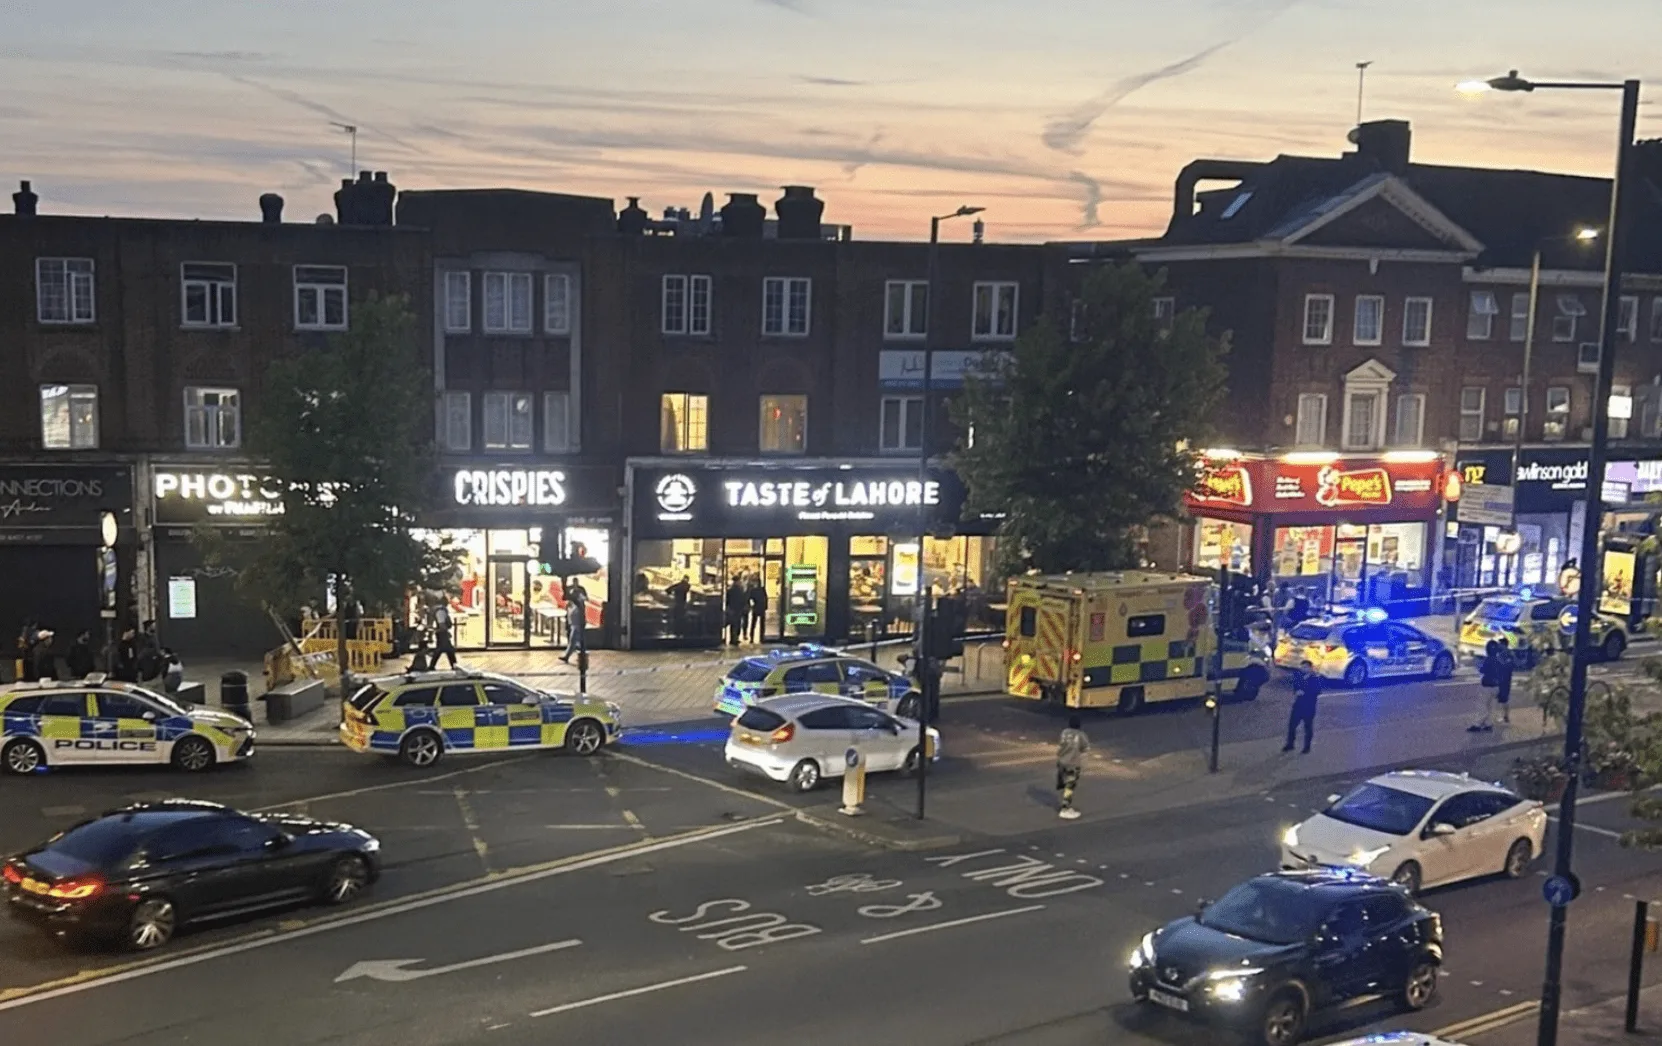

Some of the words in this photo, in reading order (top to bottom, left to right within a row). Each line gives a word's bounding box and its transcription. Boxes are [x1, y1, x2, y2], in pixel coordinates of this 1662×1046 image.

[1515, 461, 1562, 481] awlinson
[1562, 460, 1589, 485] gold
[454, 469, 566, 506] CRISPIES
[724, 481, 811, 506] TASTE
[811, 481, 833, 507] of
[834, 481, 939, 506] LAHORE
[54, 739, 158, 751] POLICE
[648, 898, 823, 951] BUS
